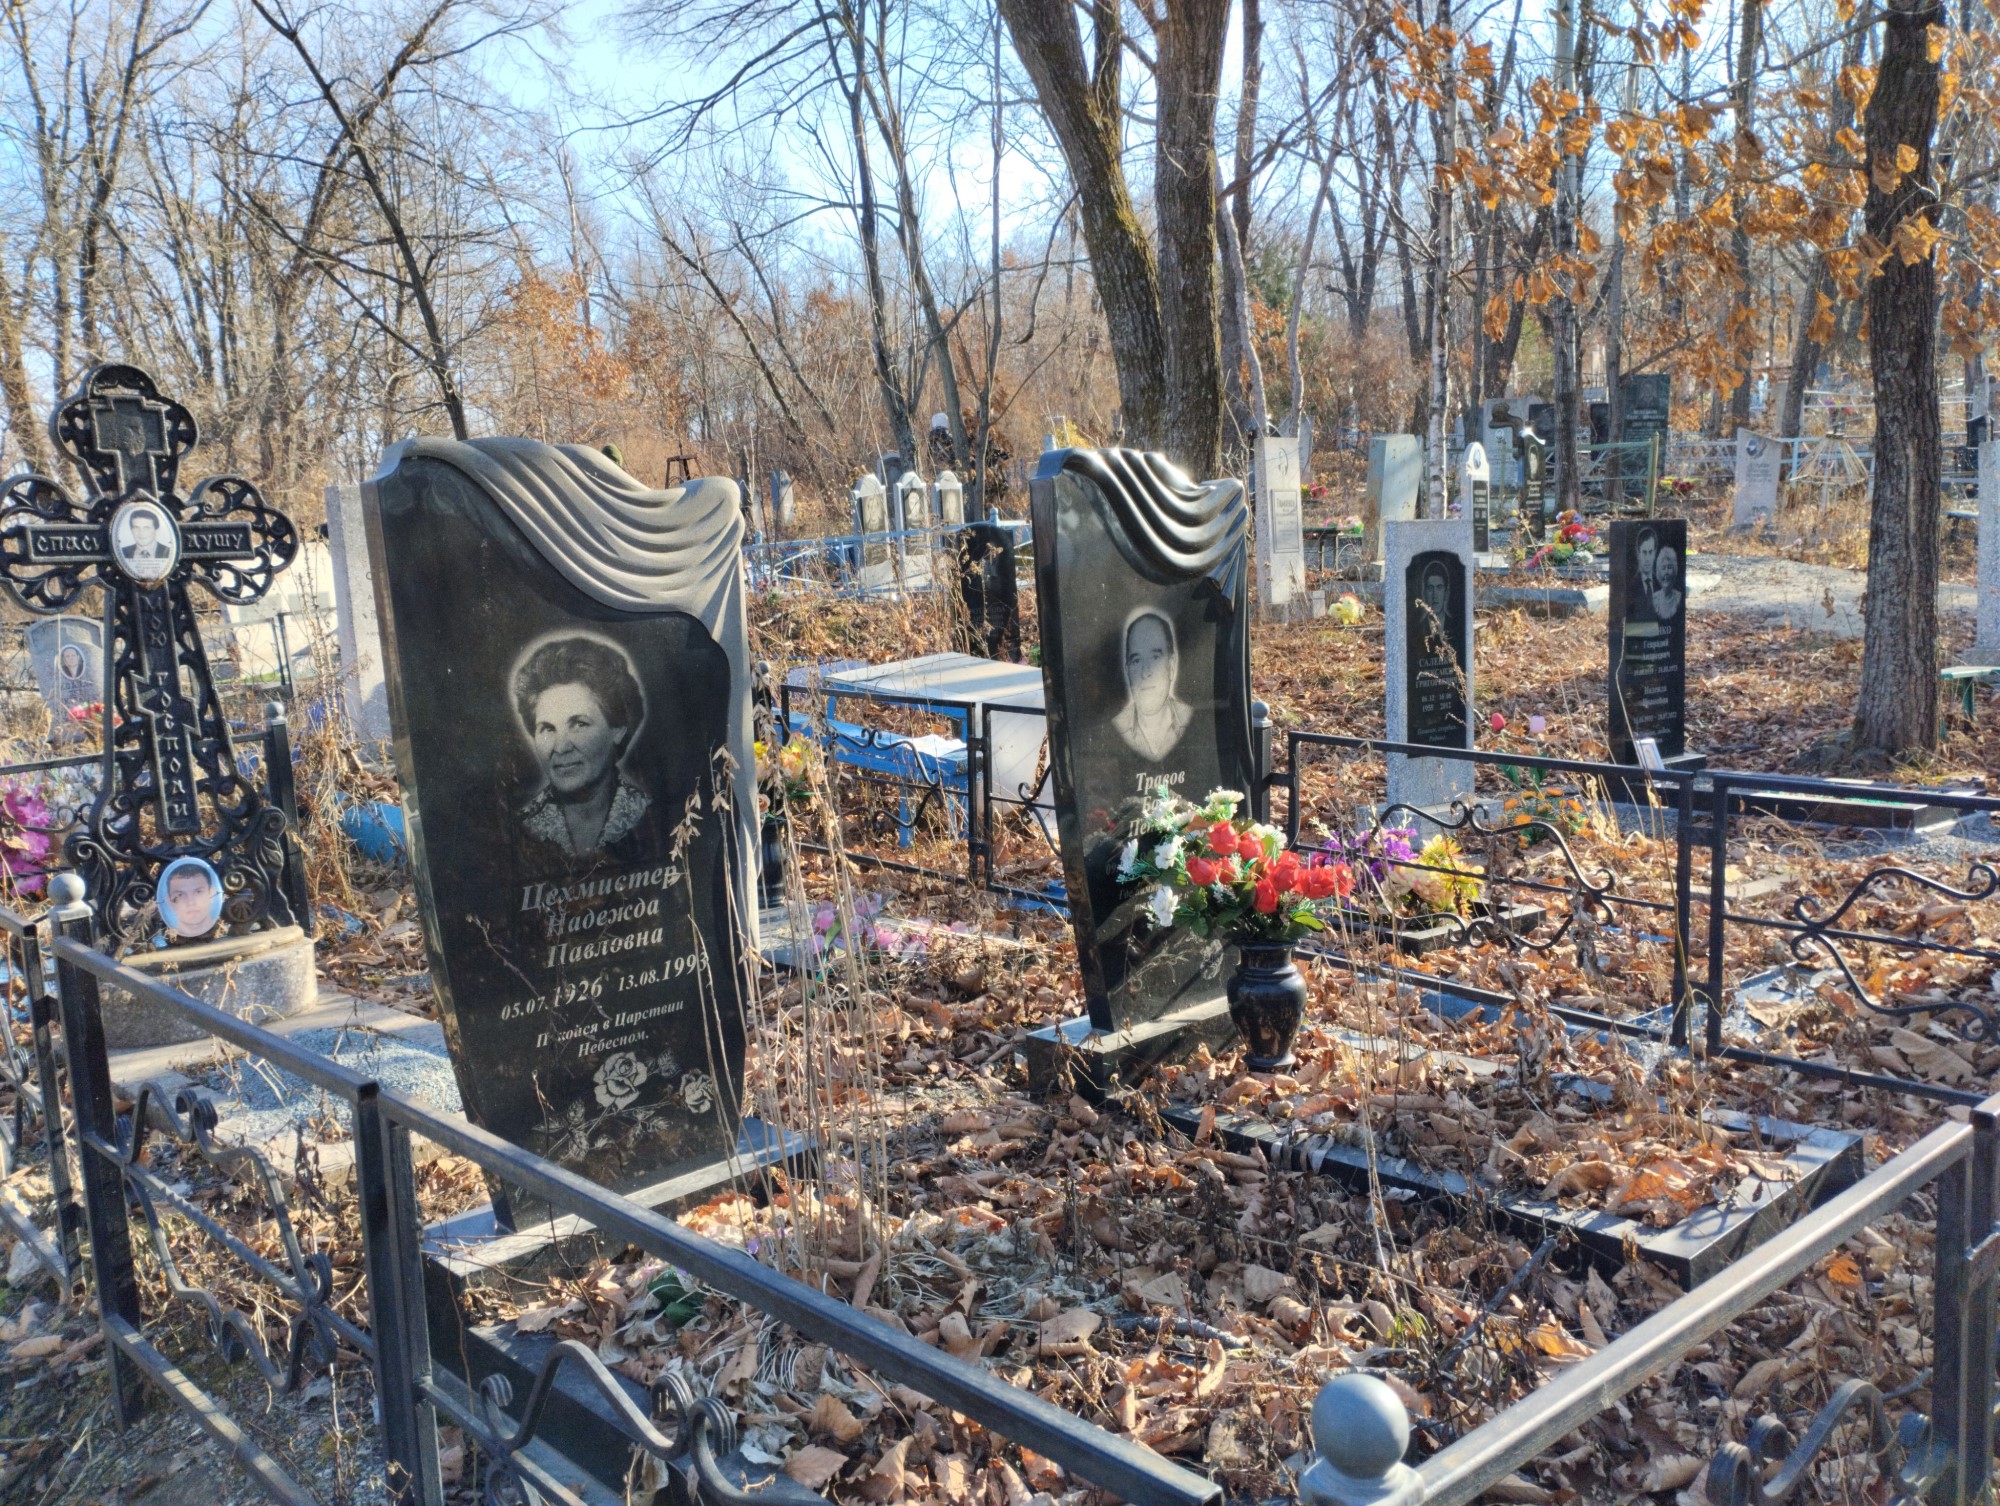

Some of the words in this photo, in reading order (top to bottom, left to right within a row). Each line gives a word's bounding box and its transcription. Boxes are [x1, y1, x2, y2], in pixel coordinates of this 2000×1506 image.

[186, 533, 243, 551] ДУШУ
[1135, 770, 1186, 796] Травов
[520, 864, 679, 913] Цехмистер
[545, 897, 660, 938] Надежда
[546, 926, 664, 969] Павловна
[617, 952, 708, 993] 13.08.1993
[535, 1021, 599, 1048] Пкойся
[602, 1019, 611, 1031] в
[614, 1000, 685, 1029] Царствии
[577, 1032, 650, 1058] Небесном.
